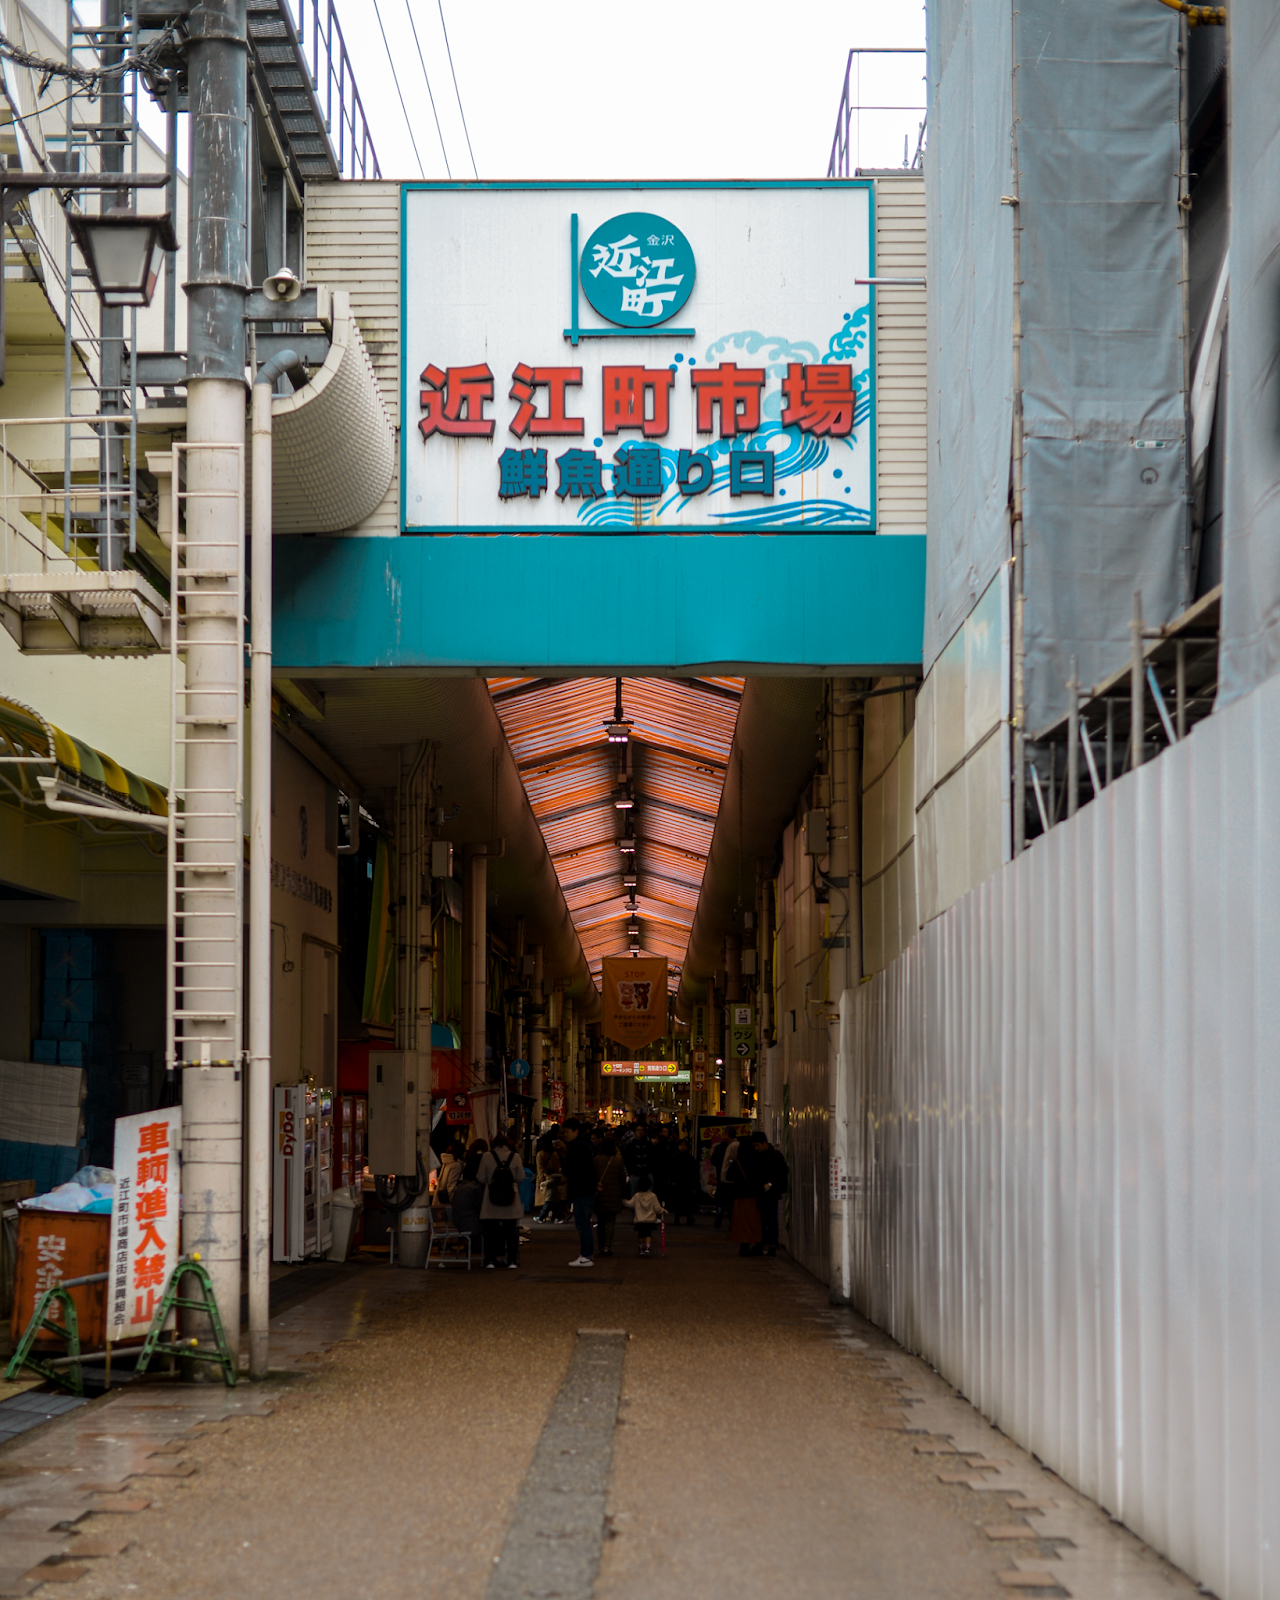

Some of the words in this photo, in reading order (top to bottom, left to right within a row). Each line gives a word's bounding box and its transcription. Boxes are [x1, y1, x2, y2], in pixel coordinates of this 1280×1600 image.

[646, 234, 674, 247] 金沢
[588, 234, 685, 318] 近江町
[418, 362, 858, 438] 近江町市場
[497, 447, 776, 500] 鮮魚通り口
[624, 970, 646, 979] STOP
[734, 1031, 753, 1040] ウシ
[283, 1111, 297, 1158] DyDo
